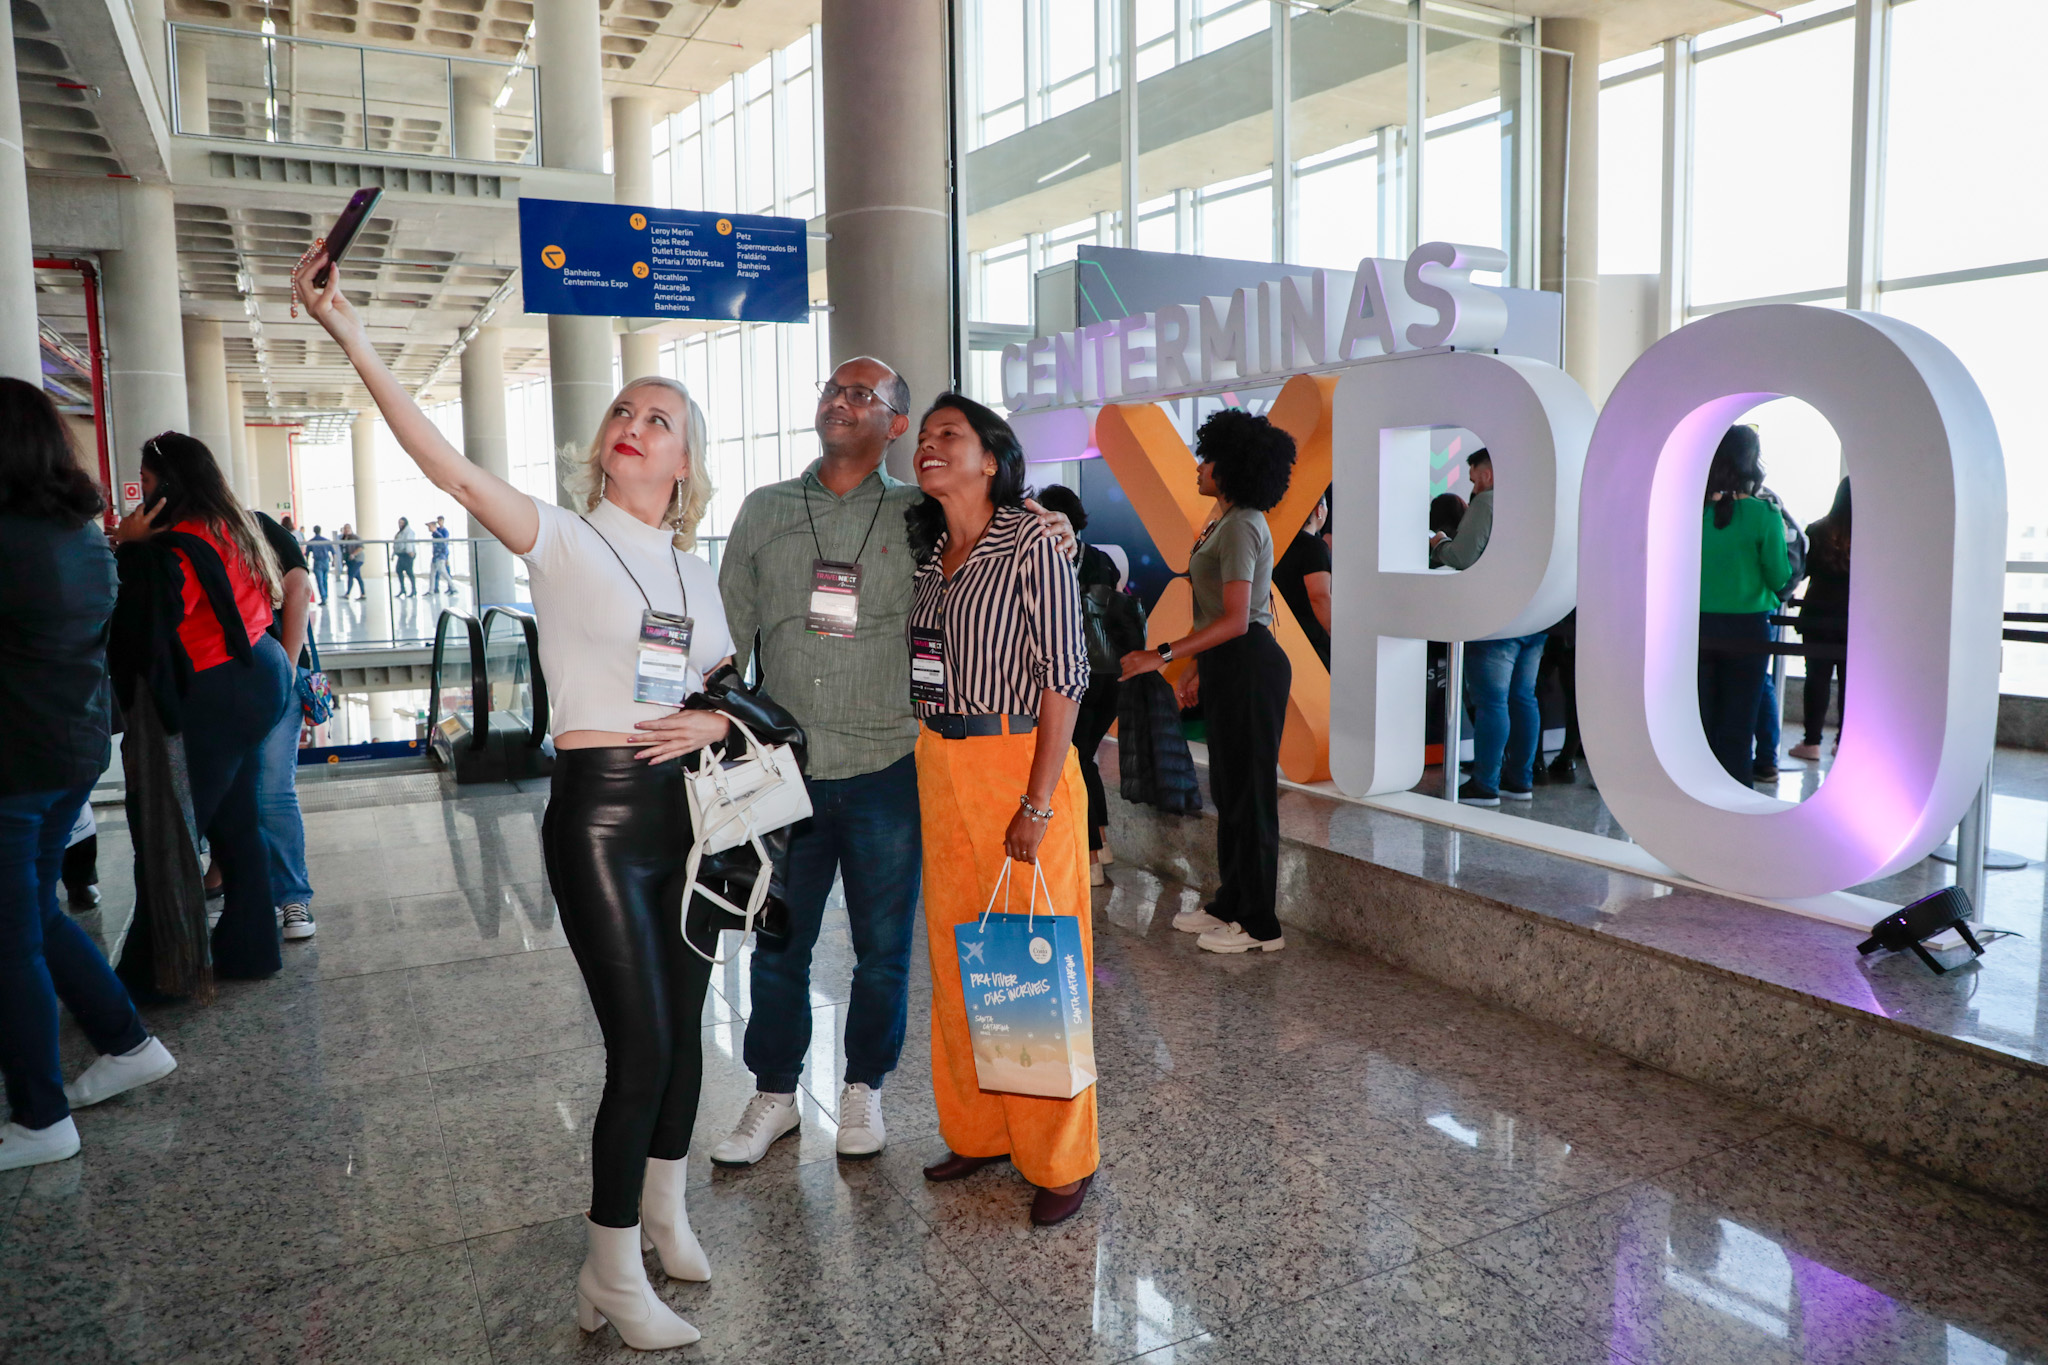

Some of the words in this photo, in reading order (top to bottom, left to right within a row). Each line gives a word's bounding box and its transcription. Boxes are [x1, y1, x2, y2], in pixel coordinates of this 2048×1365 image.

[651, 227, 670, 236] Leroy
[672, 228, 693, 236] Merlin
[736, 232, 751, 240] Petz
[651, 237, 670, 246] Lojas
[672, 238, 689, 246] Rede
[736, 242, 786, 252] Supermercados
[652, 247, 673, 255] Outlet
[675, 248, 709, 257] Electrolux
[737, 252, 766, 260] Fraldário
[652, 257, 680, 265] Portaria
[686, 258, 701, 266] 1001
[702, 259, 724, 267] Festas
[737, 262, 770, 270] Banheiros
[563, 268, 601, 277] Banheiros
[653, 273, 688, 281] Decathlon
[737, 270, 759, 279] Araujo
[563, 278, 609, 287] Centerminas
[611, 280, 628, 289] Expo
[654, 283, 690, 293] Atacarejão
[654, 293, 695, 301] Americanas
[654, 302, 690, 311] Banheiros
[1001, 241, 1508, 413] CENTERMINAS
[1002, 304, 2008, 900] XPO
[970, 973, 991, 988] PRA
[1071, 996, 1082, 1024] SANTA
[975, 1015, 993, 1023] SANTA
